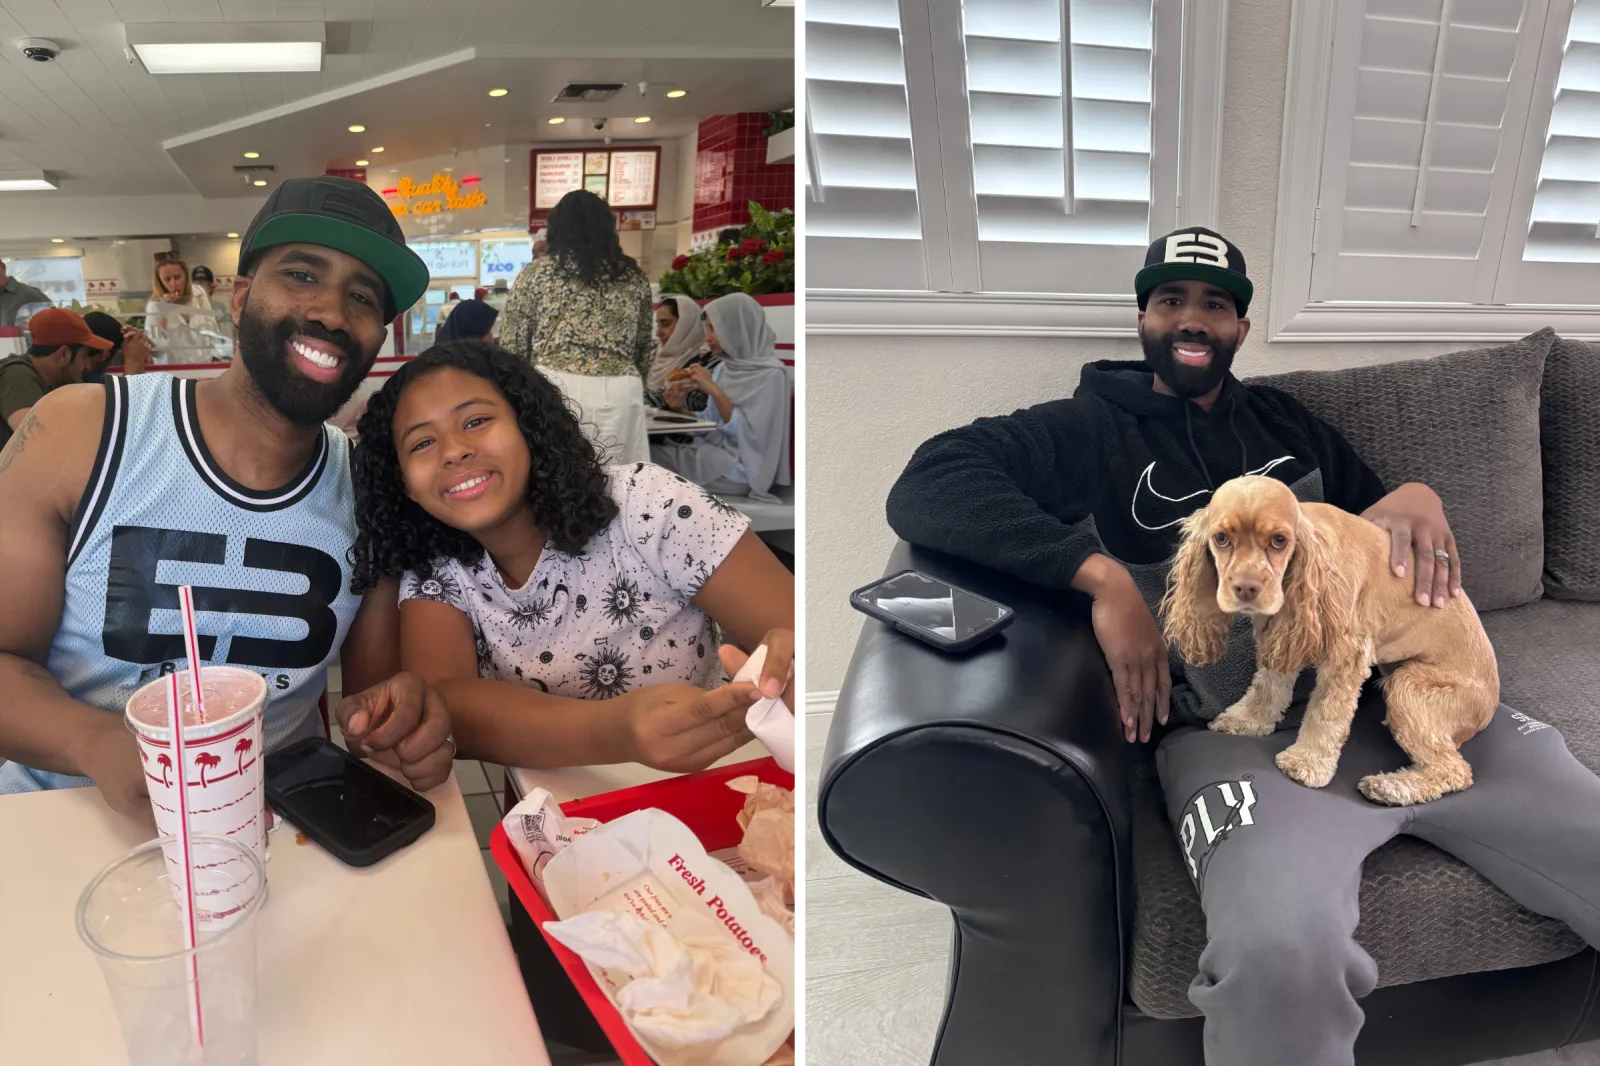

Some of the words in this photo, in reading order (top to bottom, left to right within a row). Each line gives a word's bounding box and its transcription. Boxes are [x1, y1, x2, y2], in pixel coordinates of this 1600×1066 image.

[397, 173, 458, 200] Quality
[413, 200, 441, 215] can
[445, 187, 486, 211] taste
[102, 524, 343, 669] EB
[633, 889, 642, 898] are
[644, 884, 653, 895] Our
[650, 895, 662, 906] fries
[667, 853, 707, 896] Fresh
[706, 895, 767, 965] Potatoes
